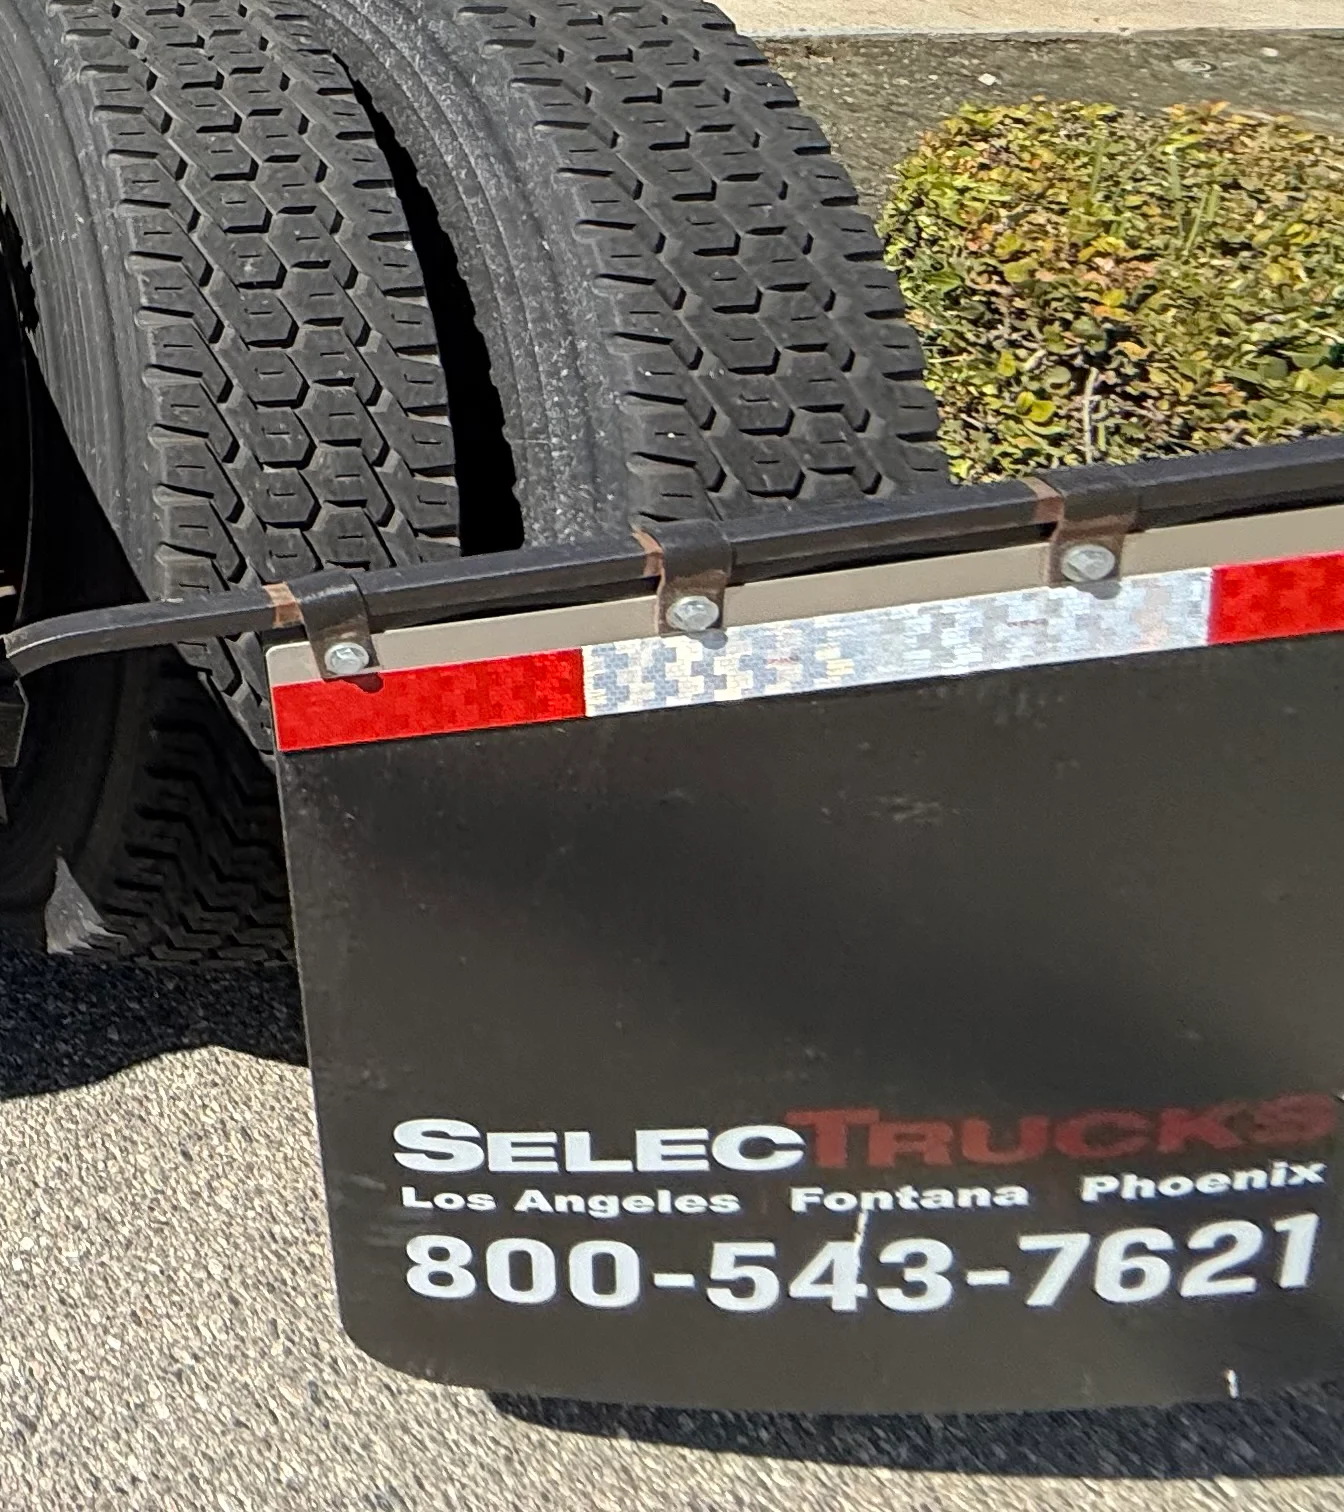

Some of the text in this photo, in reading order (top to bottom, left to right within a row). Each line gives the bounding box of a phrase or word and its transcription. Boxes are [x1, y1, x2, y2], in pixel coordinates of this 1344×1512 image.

[401, 1161, 1328, 1219] Los Angeles Fontana Phoenix
[405, 1213, 1325, 1314] 800-543-7621
